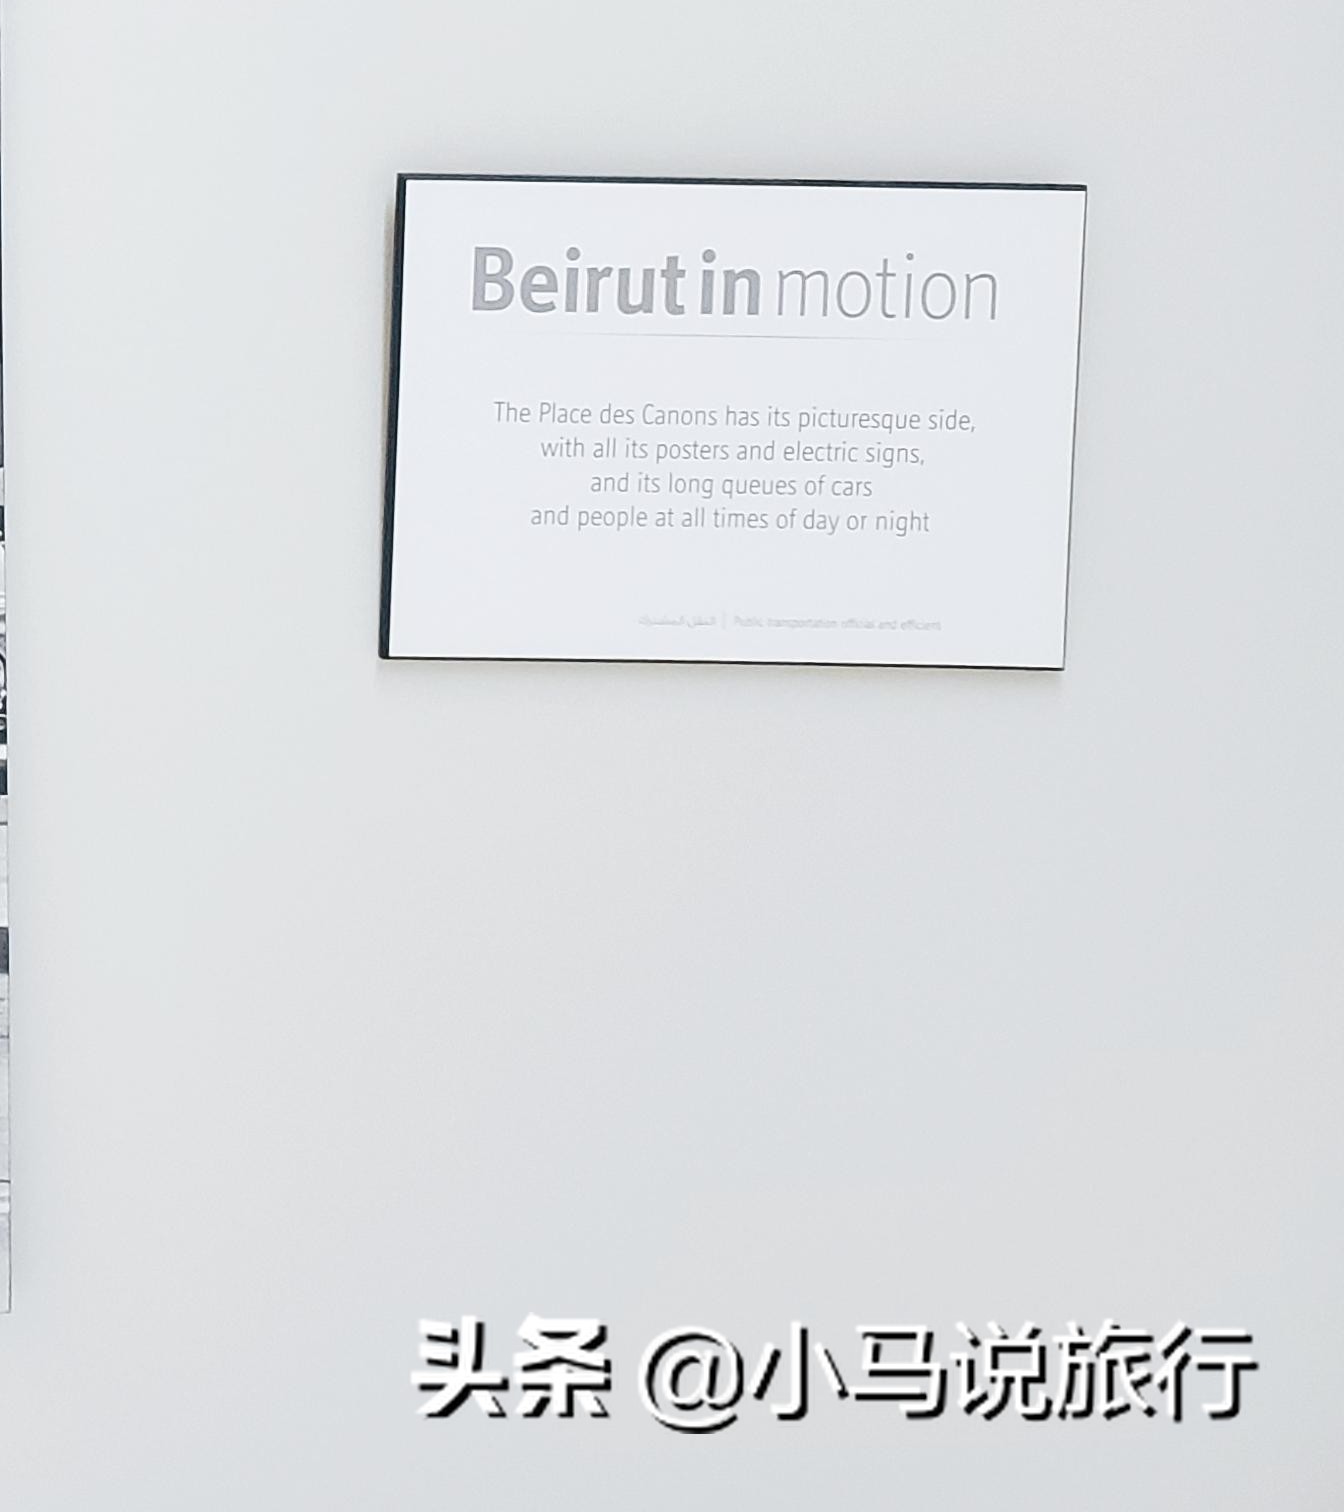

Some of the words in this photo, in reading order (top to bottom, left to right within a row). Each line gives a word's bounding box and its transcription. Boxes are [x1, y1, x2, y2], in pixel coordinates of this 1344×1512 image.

[472, 246, 687, 316] Beirut
[700, 248, 761, 316] in
[777, 253, 997, 321] motion
[493, 400, 532, 423] The
[539, 401, 593, 425] Place
[599, 402, 635, 425] des
[641, 402, 718, 427] Canons
[725, 404, 760, 427] has
[767, 405, 791, 428] its
[798, 406, 921, 435] picturesque
[927, 407, 977, 433] side,
[540, 435, 585, 458] with
[592, 436, 617, 459] all
[624, 436, 649, 460] its
[655, 438, 730, 465] posters
[736, 439, 776, 462] and
[783, 439, 860, 463] electric
[864, 441, 925, 469] signs,
[590, 471, 630, 493] and
[637, 471, 661, 494] its
[668, 471, 714, 500] long
[721, 478, 798, 500] queues
[804, 473, 825, 496] of
[830, 480, 873, 497] cars
[530, 504, 570, 526] and
[577, 505, 649, 532] people
[654, 507, 675, 528] at
[680, 506, 706, 529] all
[712, 507, 769, 529] times
[775, 507, 797, 530] of
[802, 508, 841, 536] day
[846, 514, 868, 531] or
[875, 510, 930, 538] night
